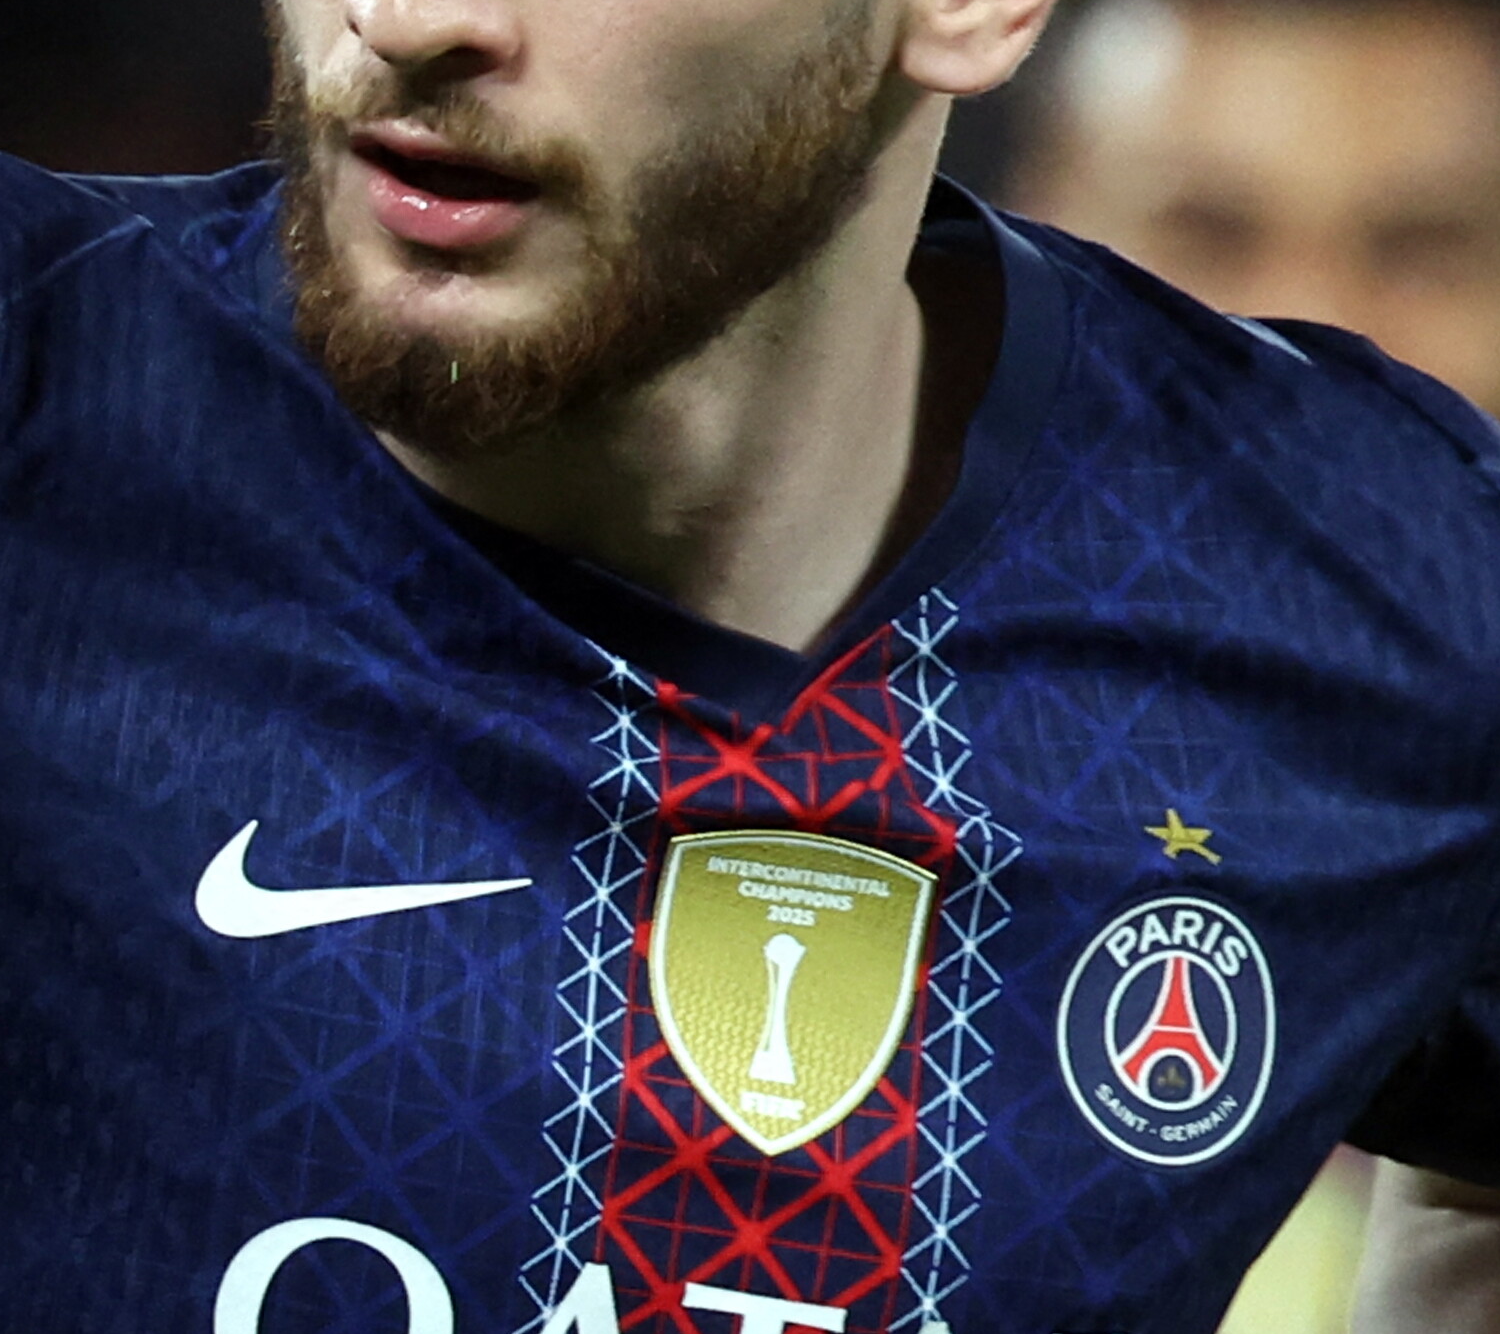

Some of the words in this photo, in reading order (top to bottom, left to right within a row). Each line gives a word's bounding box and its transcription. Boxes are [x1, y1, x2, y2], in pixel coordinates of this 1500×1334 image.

[706, 855, 891, 898] INTERCONTINENTAL
[737, 880, 855, 912] CHAMPIONS
[767, 905, 818, 927] 2025
[1105, 910, 1249, 977] PARIS
